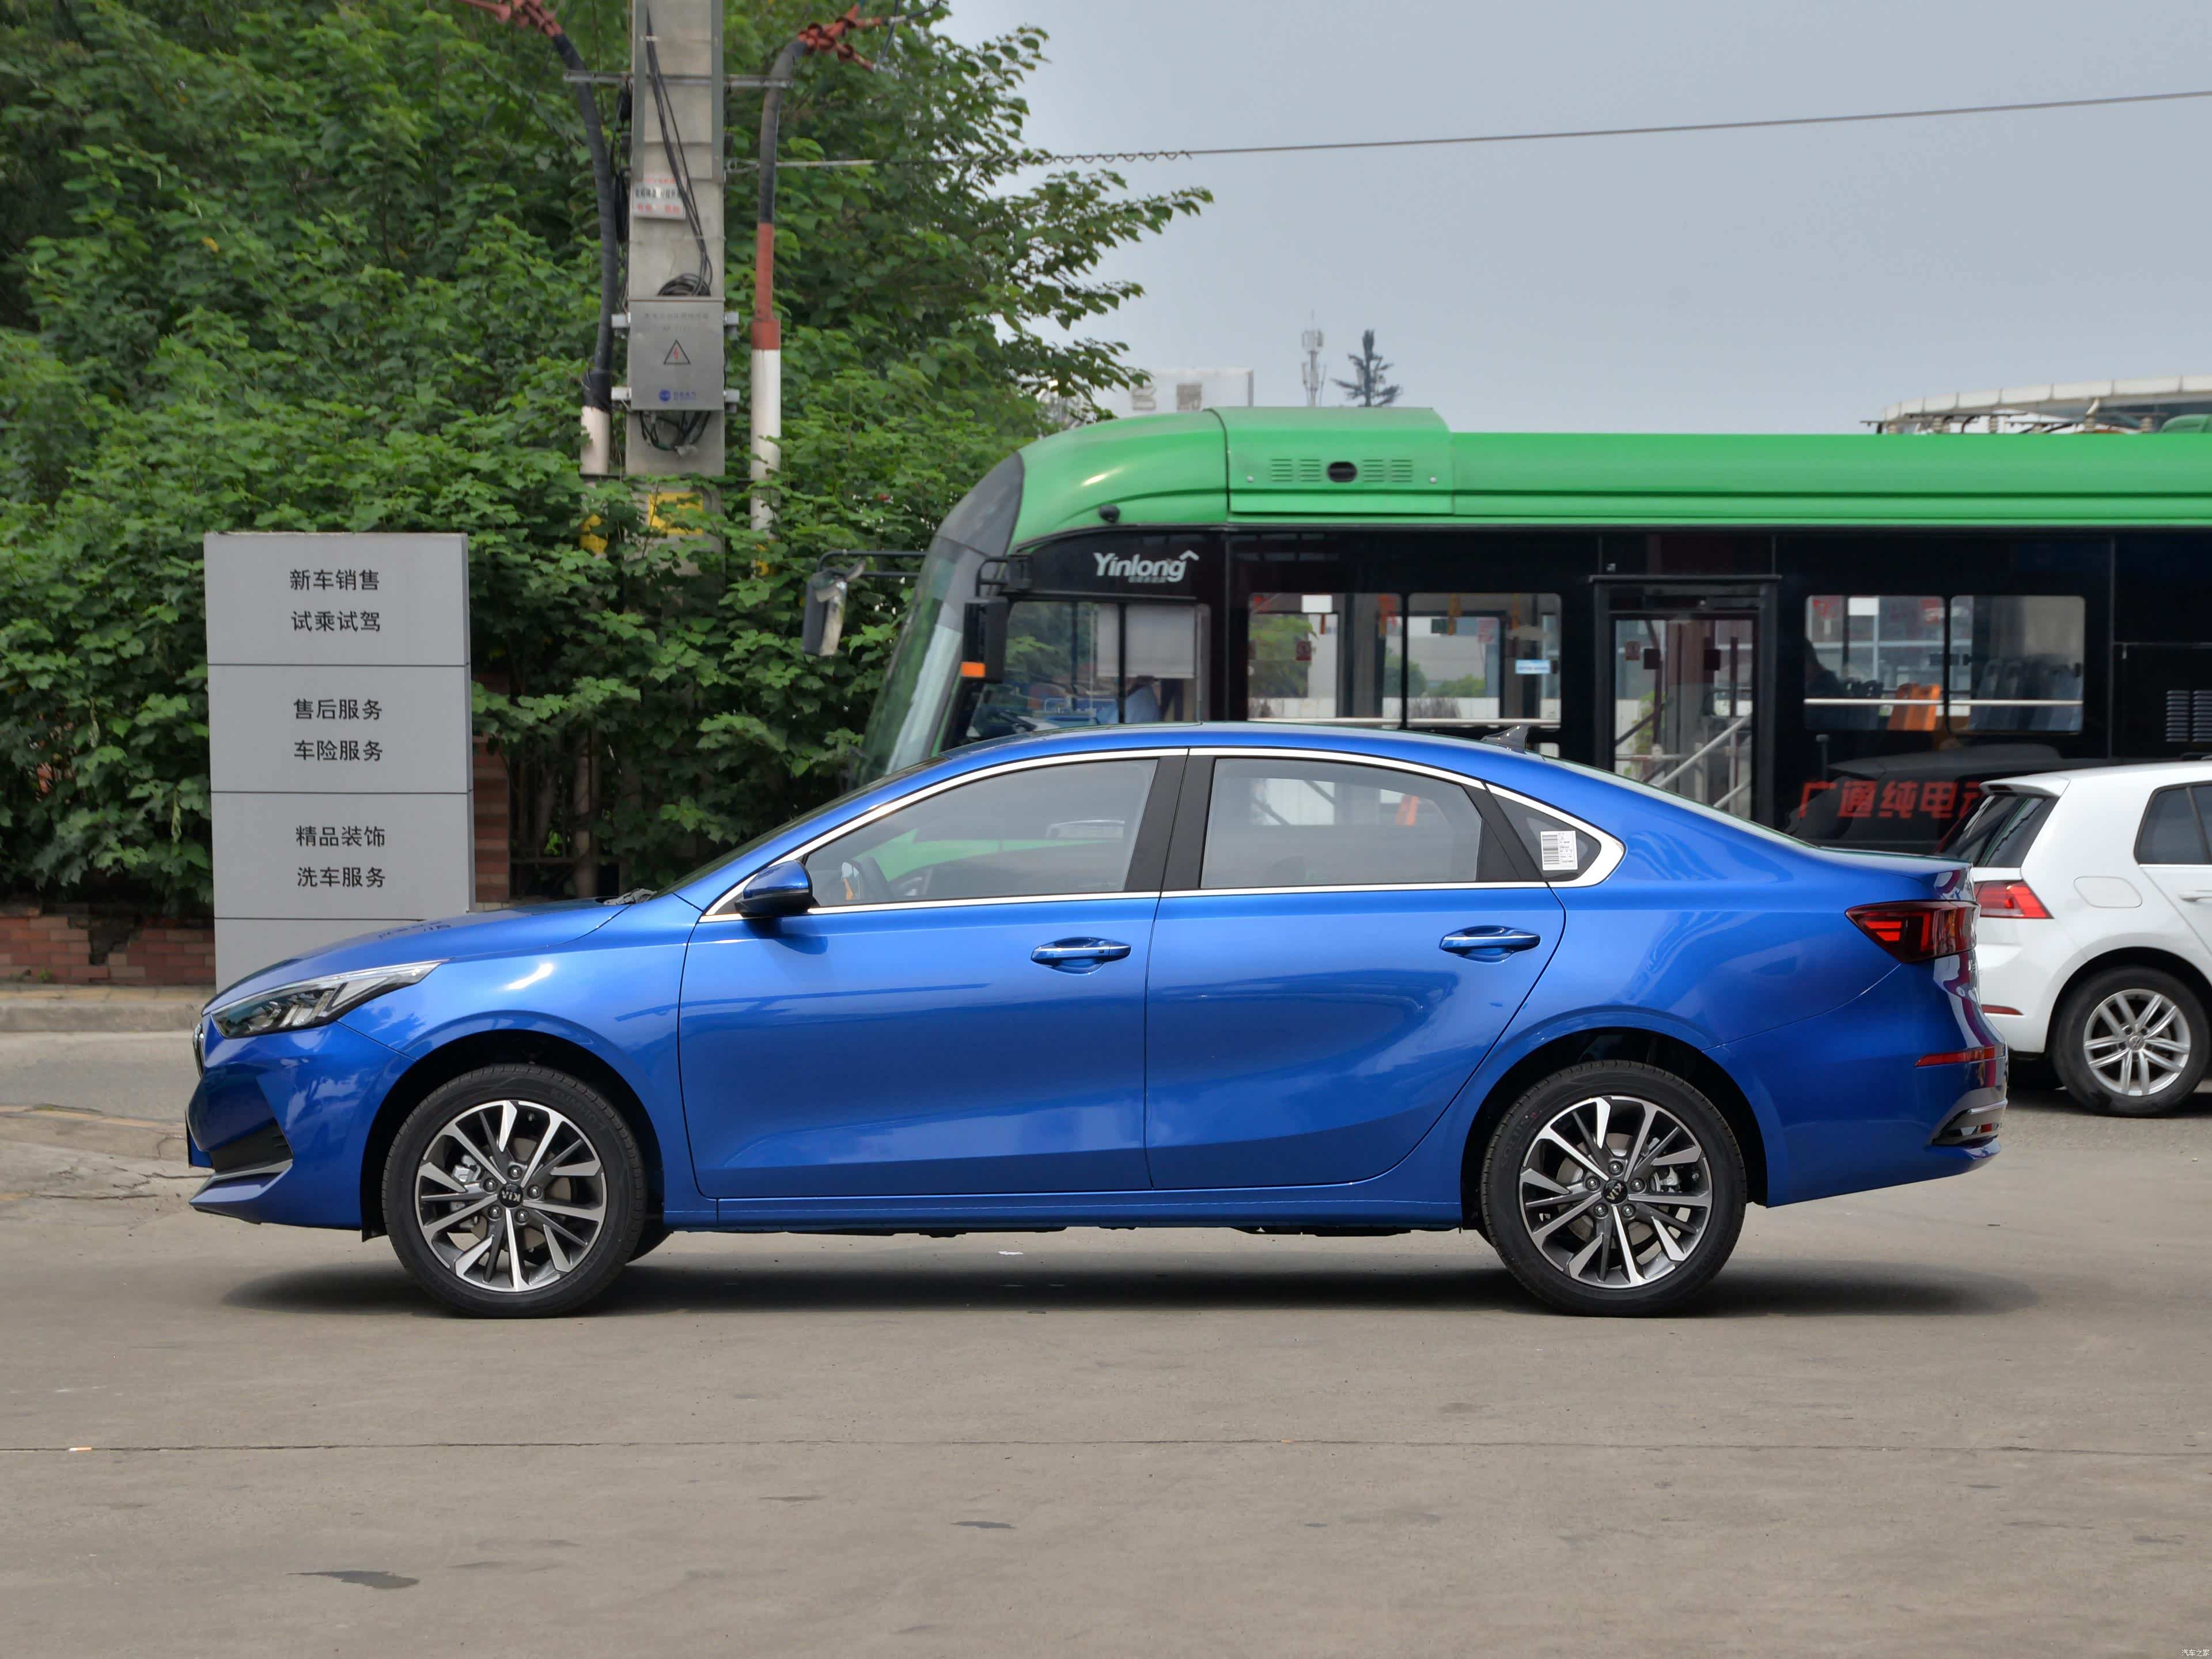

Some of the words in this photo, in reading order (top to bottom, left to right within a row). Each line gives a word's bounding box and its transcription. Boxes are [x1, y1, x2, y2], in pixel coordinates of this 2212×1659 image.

[1093, 551, 1187, 583] Yinlong
[290, 569, 380, 590] 新车销售
[291, 611, 380, 632] 试乘试驾
[293, 698, 382, 721] 售后服务
[294, 740, 383, 762] 车险服务
[296, 825, 385, 847] 精品装饰
[297, 866, 385, 888] 洗车服务
